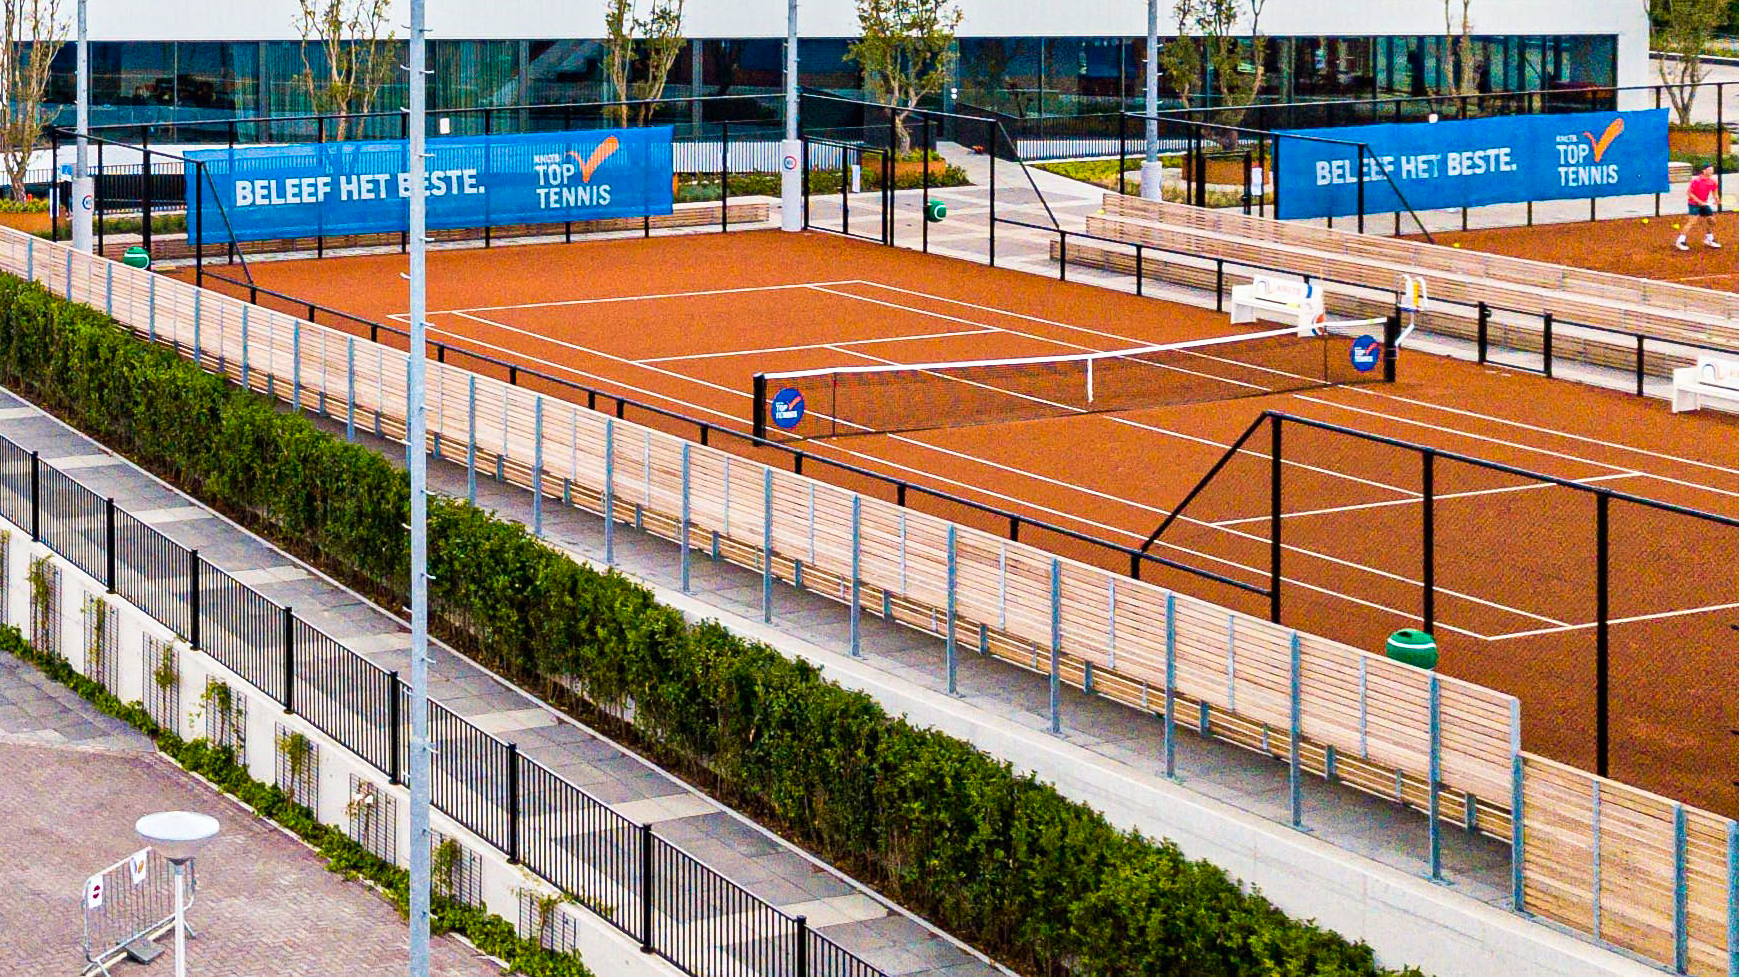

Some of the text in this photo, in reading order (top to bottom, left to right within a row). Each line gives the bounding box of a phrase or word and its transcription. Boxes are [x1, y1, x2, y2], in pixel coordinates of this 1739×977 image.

[1316, 147, 1517, 186] BELEEF HET BESTE.
[1556, 144, 1590, 165] TOP
[534, 163, 575, 186] TOP
[1557, 164, 1619, 187] TENNIS
[235, 175, 331, 207] BELEEF
[340, 173, 391, 202] HET
[536, 184, 612, 210] TENNIS
